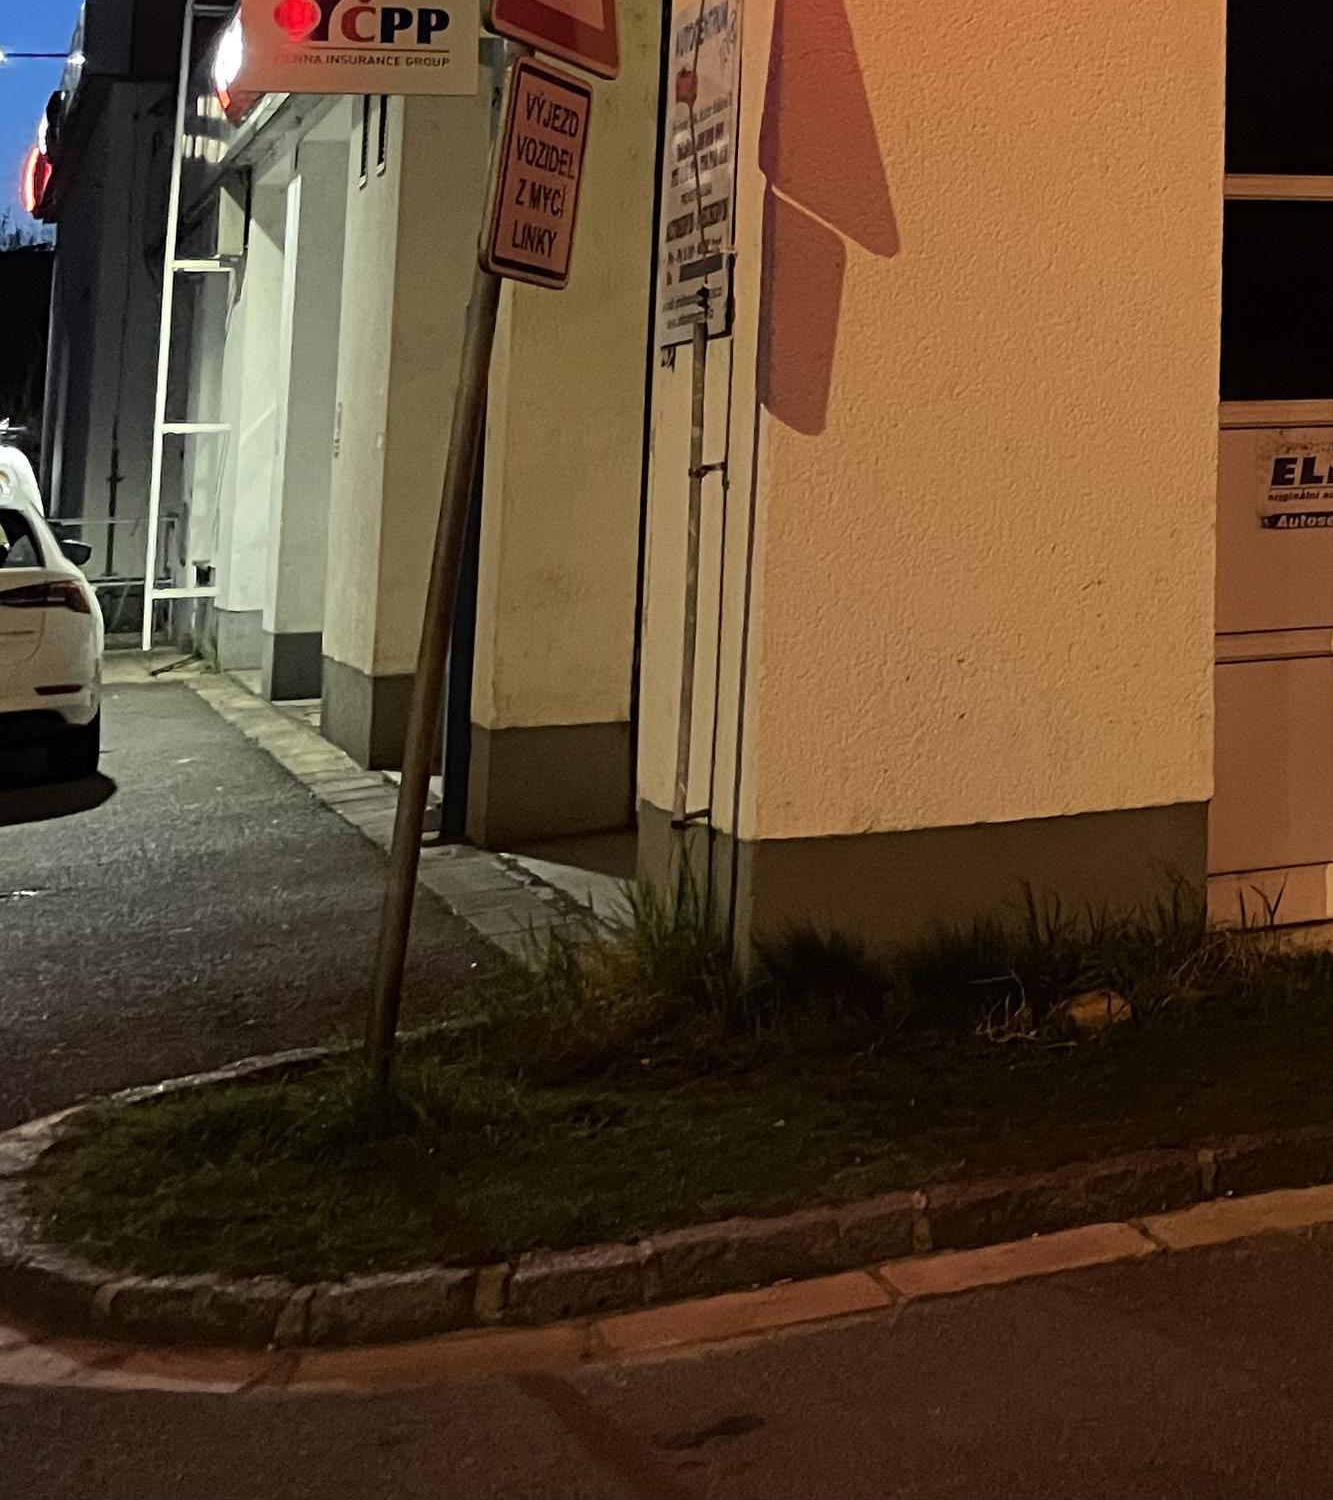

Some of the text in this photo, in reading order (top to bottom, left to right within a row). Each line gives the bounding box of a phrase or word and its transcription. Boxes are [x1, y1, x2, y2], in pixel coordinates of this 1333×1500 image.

[326, 54, 401, 66] INSURANCE
[406, 57, 450, 67] GROUP
[526, 92, 579, 138] VÝJEZD
[517, 135, 575, 180] VOZIDEL
[515, 178, 527, 206] Z
[512, 220, 558, 257] LINKY
